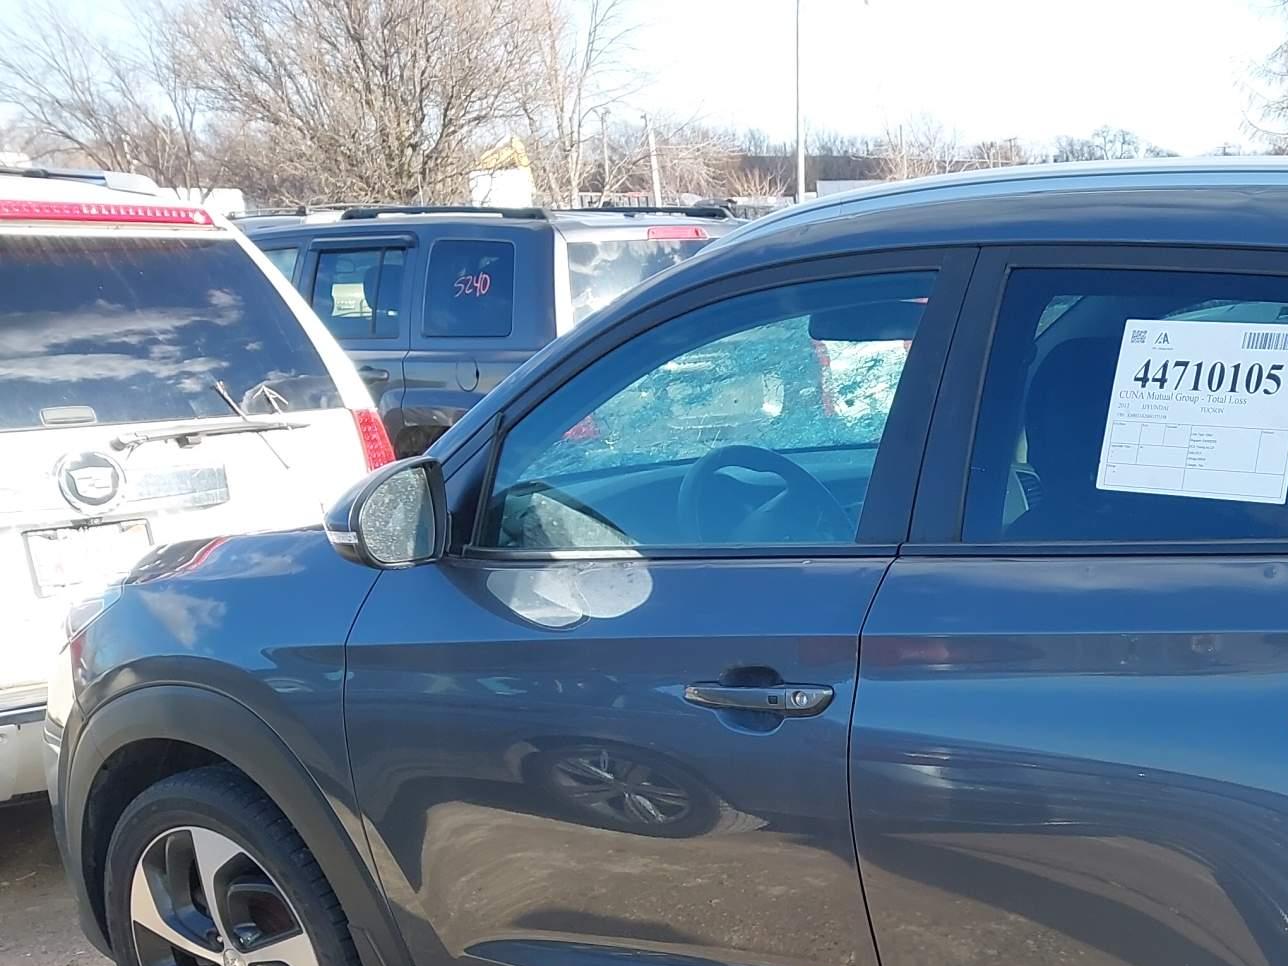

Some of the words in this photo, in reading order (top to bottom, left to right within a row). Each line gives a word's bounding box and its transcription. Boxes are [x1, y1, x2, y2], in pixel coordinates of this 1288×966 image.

[1133, 358, 1285, 396] 44710105
[1118, 390, 1144, 400] CUNA
[1146, 391, 1174, 401] Mutual
[1175, 392, 1200, 405] Group
[1206, 394, 1226, 404] Total
[1228, 395, 1248, 405] Loss
